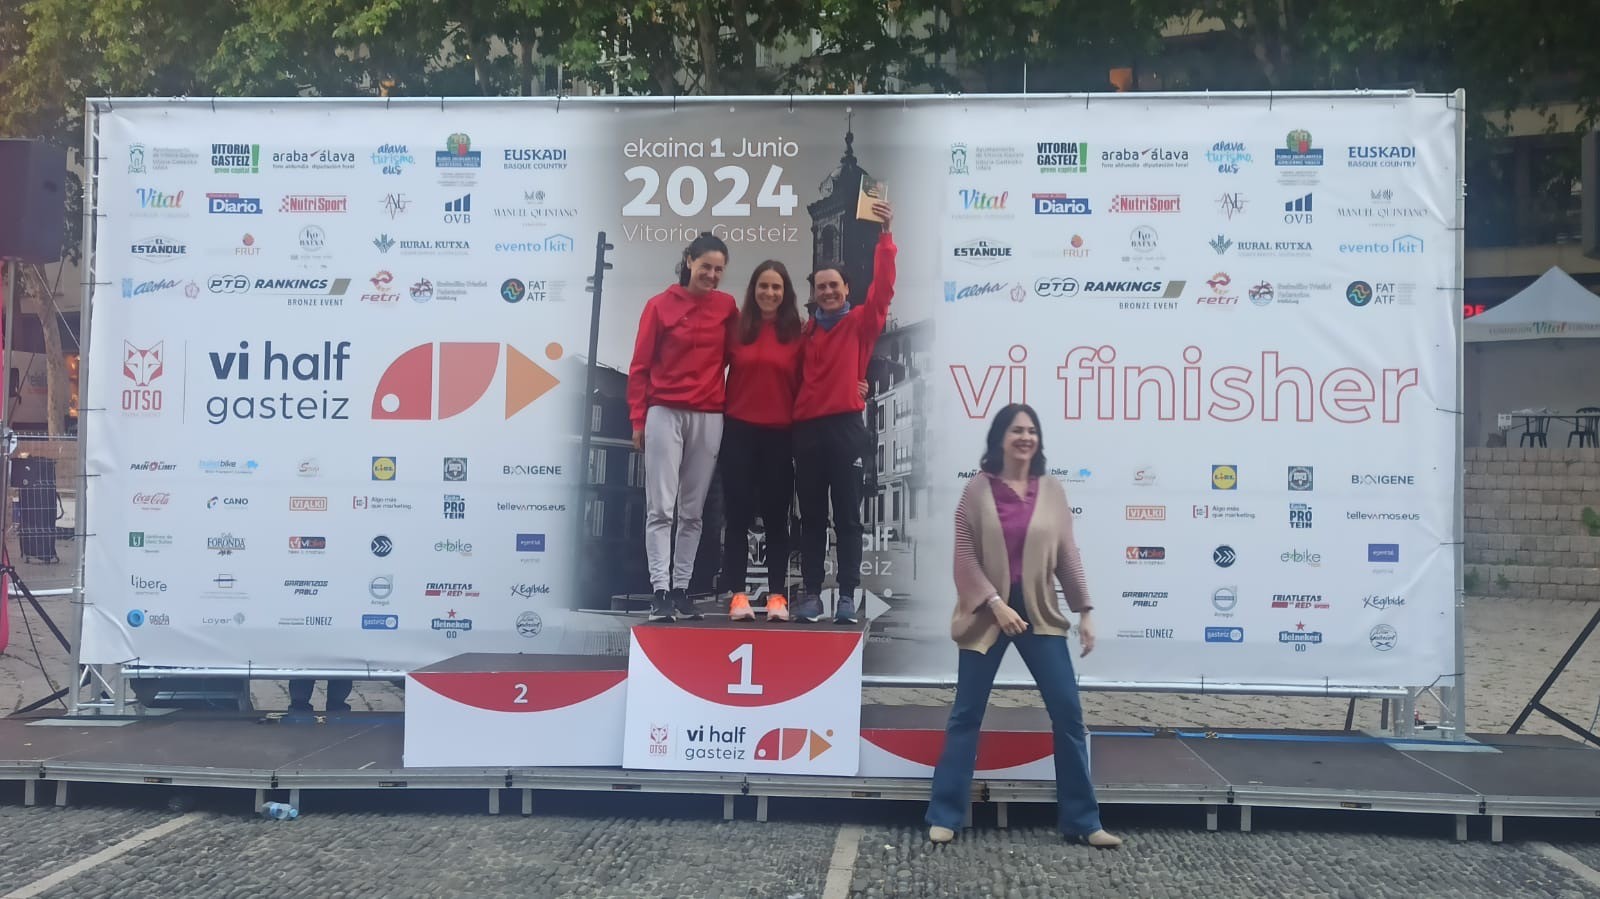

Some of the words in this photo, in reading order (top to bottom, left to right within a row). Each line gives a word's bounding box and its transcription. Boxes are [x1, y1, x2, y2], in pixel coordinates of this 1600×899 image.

[211, 143, 250, 154] VITORIA
[623, 137, 704, 158] ekaina
[710, 138, 725, 157] 1
[732, 137, 799, 158] Junio
[1037, 142, 1078, 154] VITORIA
[1348, 146, 1416, 158] EUSKADI
[272, 149, 309, 162] araba
[319, 149, 355, 162] álava
[504, 149, 567, 161] EUSKADI
[1101, 148, 1139, 160] araba
[1151, 148, 1189, 160] álava
[211, 155, 250, 166] GASTEIZ
[1036, 155, 1078, 166] GASTEIZ
[622, 164, 799, 217] 2024
[136, 187, 185, 209] Vital
[959, 188, 1009, 210] Vital
[213, 199, 257, 213] Diario
[1039, 200, 1086, 214] Diario
[443, 214, 471, 224] OVB
[1284, 214, 1313, 225] OVB
[622, 223, 698, 242] Vitoria
[711, 223, 799, 242] Gasteiz
[400, 240, 432, 249] RURAL
[435, 240, 470, 249] KUTXA
[495, 242, 541, 252] evento
[550, 241, 567, 252] kit
[1237, 241, 1272, 250] RURAL
[1275, 241, 1312, 250] KUTXA
[1339, 243, 1389, 253] evento
[1399, 242, 1416, 253] kit
[235, 247, 261, 256] FRUT
[1063, 249, 1090, 258] FRUT
[210, 279, 247, 289] PTO
[254, 279, 328, 290] RANKINGS
[529, 281, 546, 290] FAT
[1038, 282, 1075, 292] PTO
[1084, 281, 1162, 292] RANKINGS
[1376, 283, 1395, 292] FAT
[527, 293, 546, 301] ATF
[1374, 296, 1395, 304] ATF
[1119, 302, 1150, 310] BRONZE
[1154, 302, 1178, 310] EVENT
[209, 341, 249, 380] vi
[263, 341, 351, 381] half
[949, 345, 1027, 419] vi
[1057, 345, 1418, 424] finisher
[122, 390, 162, 411] OTSO
[206, 390, 350, 425] gasteiz
[207, 539, 245, 549] FORONDA
[306, 616, 333, 626] EUNEIZ
[433, 620, 470, 629] Heineken
[1146, 629, 1173, 638] EUNEIZ
[1281, 632, 1321, 642] Heineken
[728, 643, 764, 695] 1
[513, 683, 528, 704] 2
[687, 725, 704, 742] vi
[709, 725, 746, 743] half
[649, 744, 668, 755] OTSO
[685, 746, 745, 760] gasteiz
